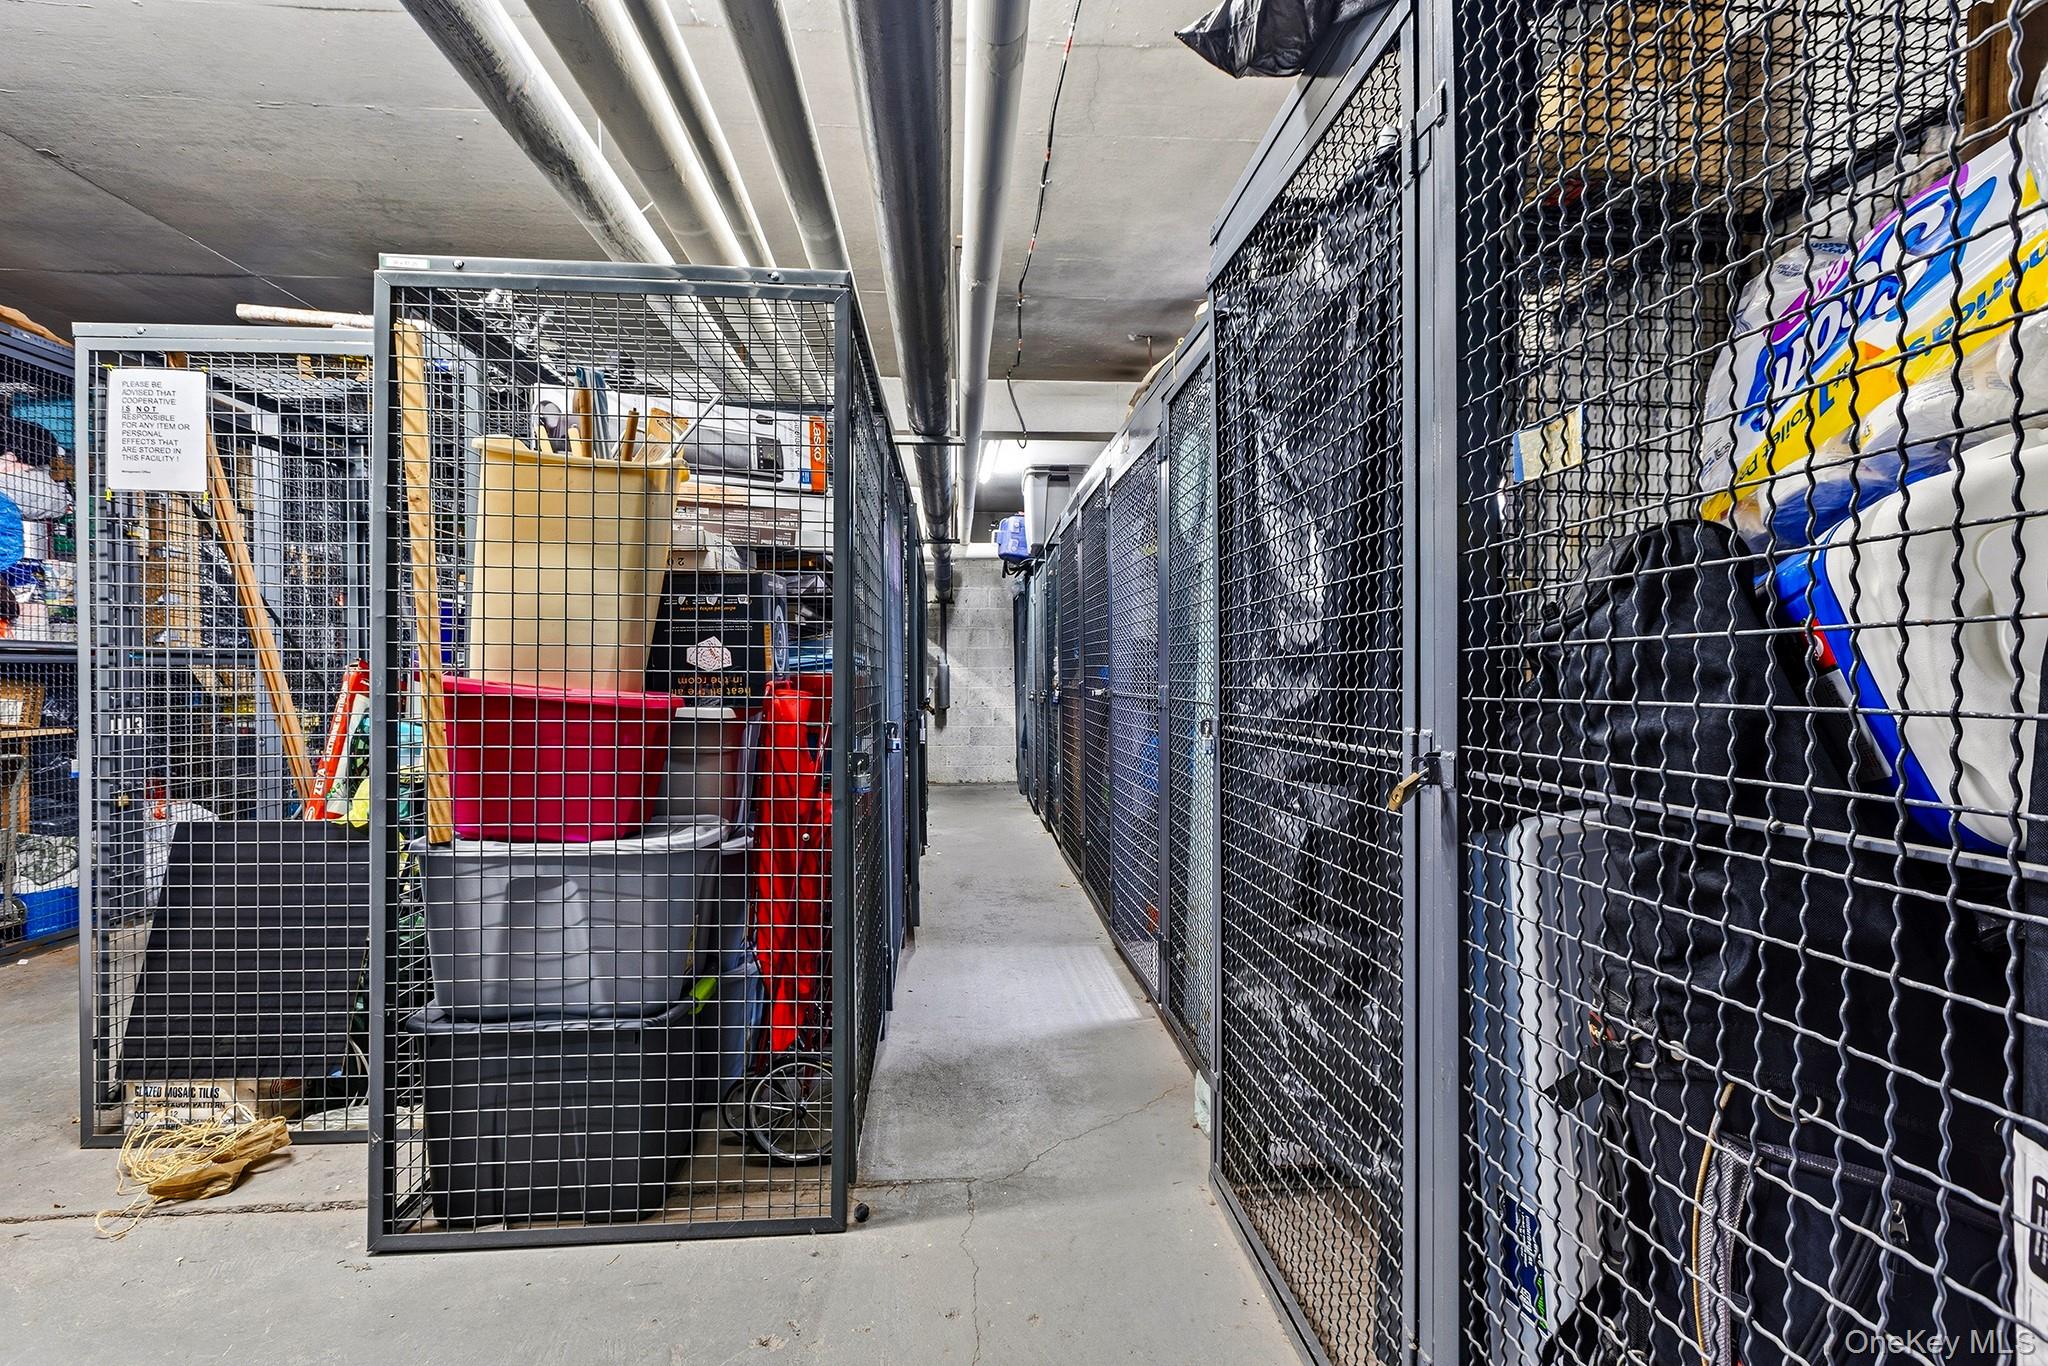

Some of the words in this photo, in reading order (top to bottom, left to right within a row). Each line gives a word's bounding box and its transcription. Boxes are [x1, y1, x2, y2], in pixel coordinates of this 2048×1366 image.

[1756, 202, 1948, 430] Scott
[151, 381, 162, 389] BE
[121, 389, 154, 397] ADVISED
[121, 397, 177, 406] COOPERATIVE
[121, 405, 131, 414] IS
[136, 406, 159, 414] NOT
[121, 413, 175, 422] RESPONSIBLE
[121, 421, 138, 429] FOR
[177, 423, 191, 431] OR
[121, 429, 163, 438] PERSONAL
[121, 438, 156, 446] EFFECTS
[121, 446, 138, 454] ARE
[138, 446, 172, 454] STORED
[121, 454, 139, 462] THIS
[140, 454, 175, 463] FACILITY
[677, 676, 707, 685] room
[726, 687, 751, 697] heat
[313, 768, 326, 796] ZETA
[134, 1085, 162, 1098] GLAZED
[164, 1086, 197, 1099] MOSAIC
[192, 1101, 226, 1109] PATTRN
